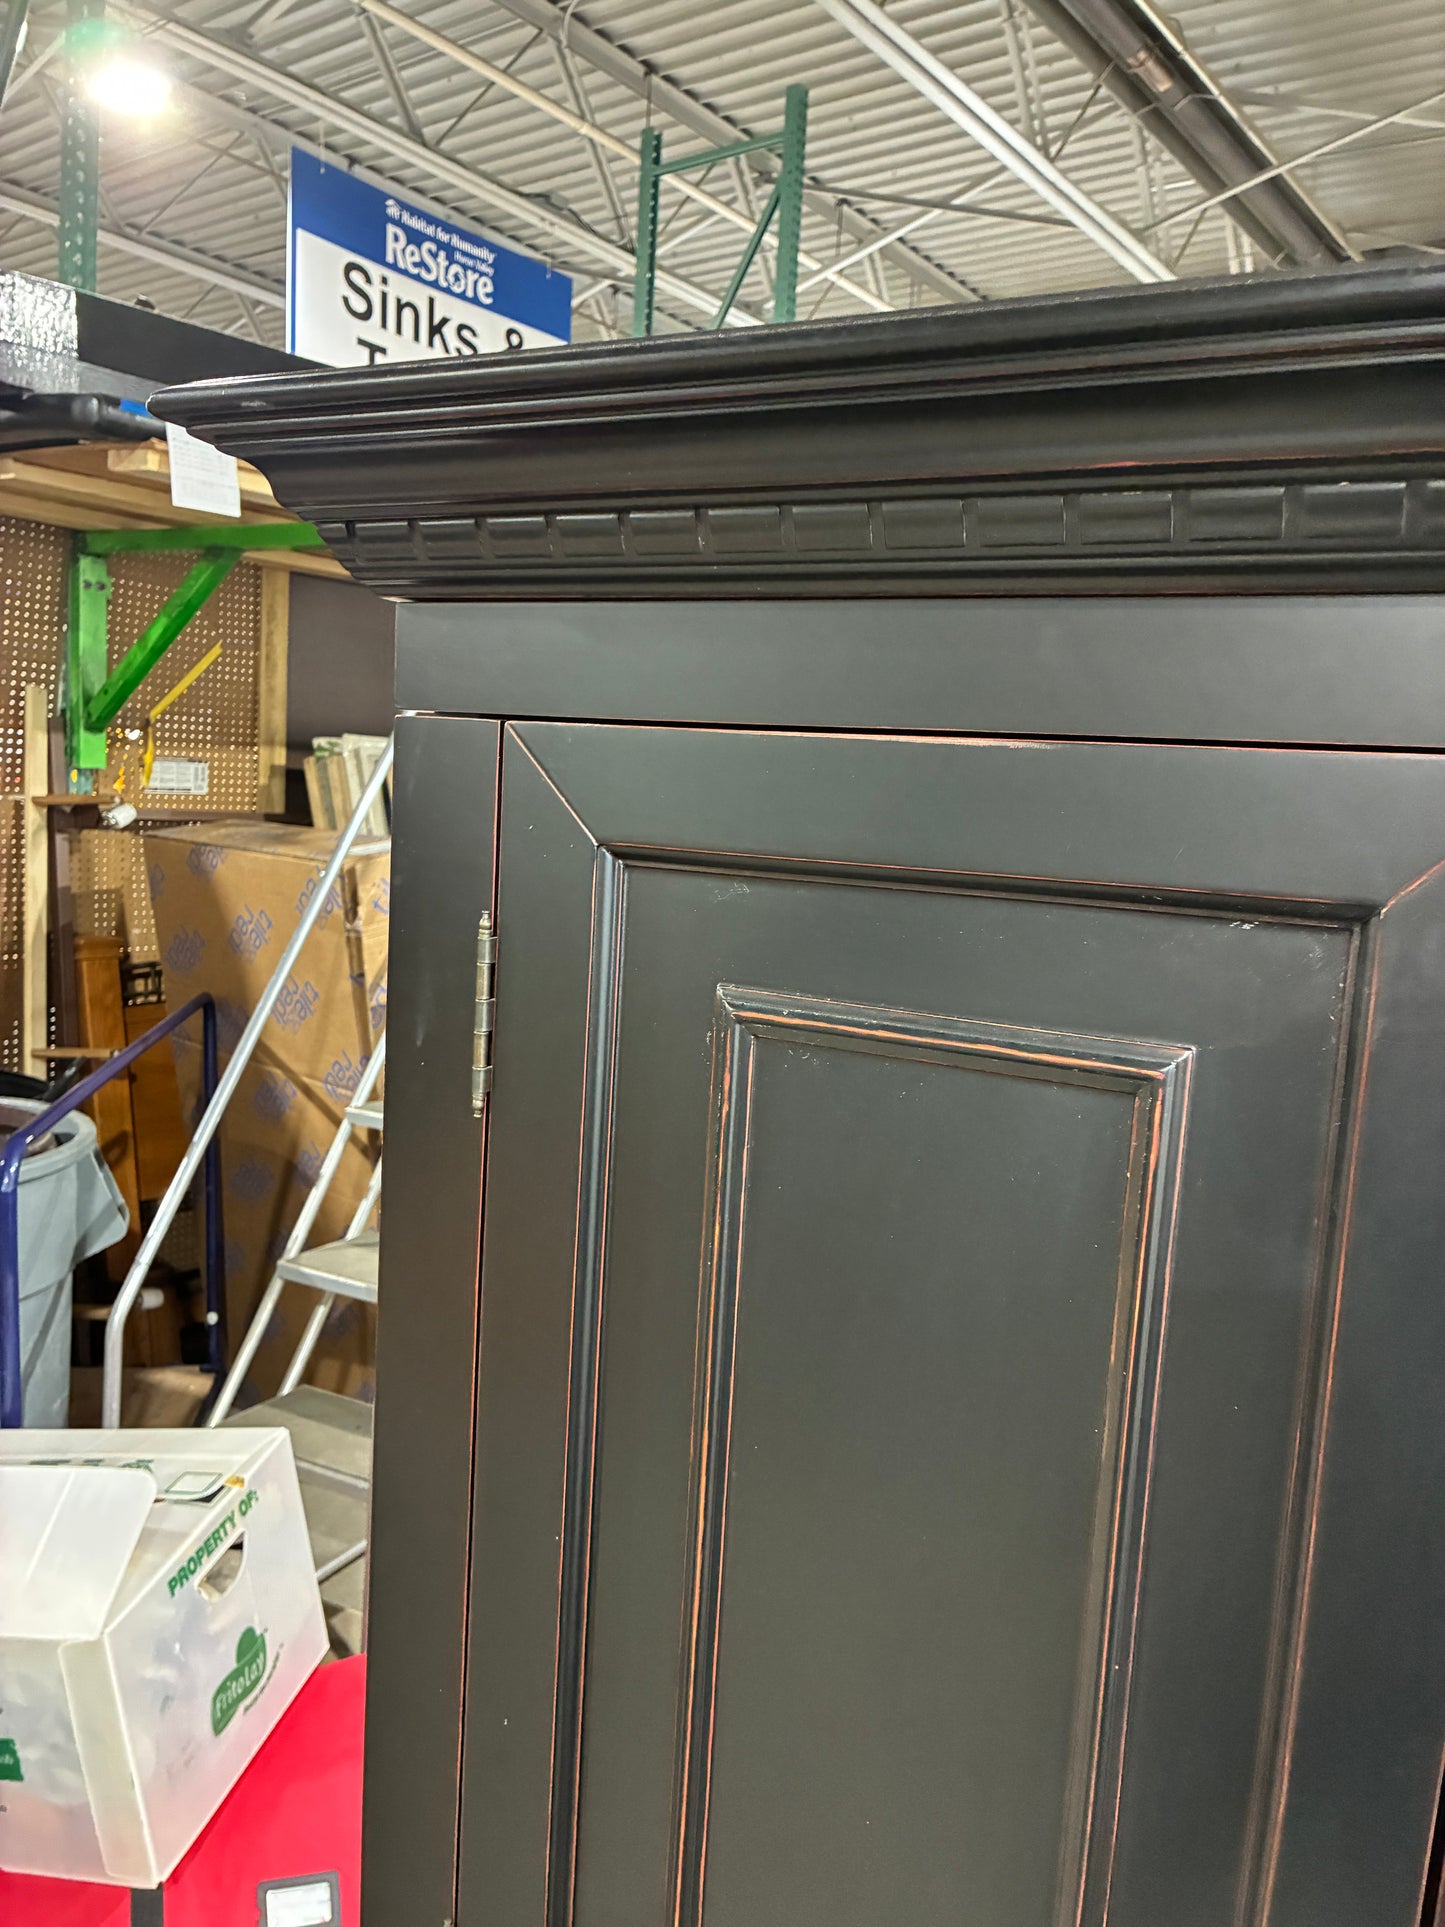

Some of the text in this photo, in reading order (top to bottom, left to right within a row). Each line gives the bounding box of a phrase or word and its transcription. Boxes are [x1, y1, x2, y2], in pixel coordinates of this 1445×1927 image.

[384, 222, 495, 305] ReStore
[401, 209, 495, 265] Habitat for Humanity
[342, 261, 478, 356] Sinks
[167, 1489, 259, 1599] PROPERTY OF:
